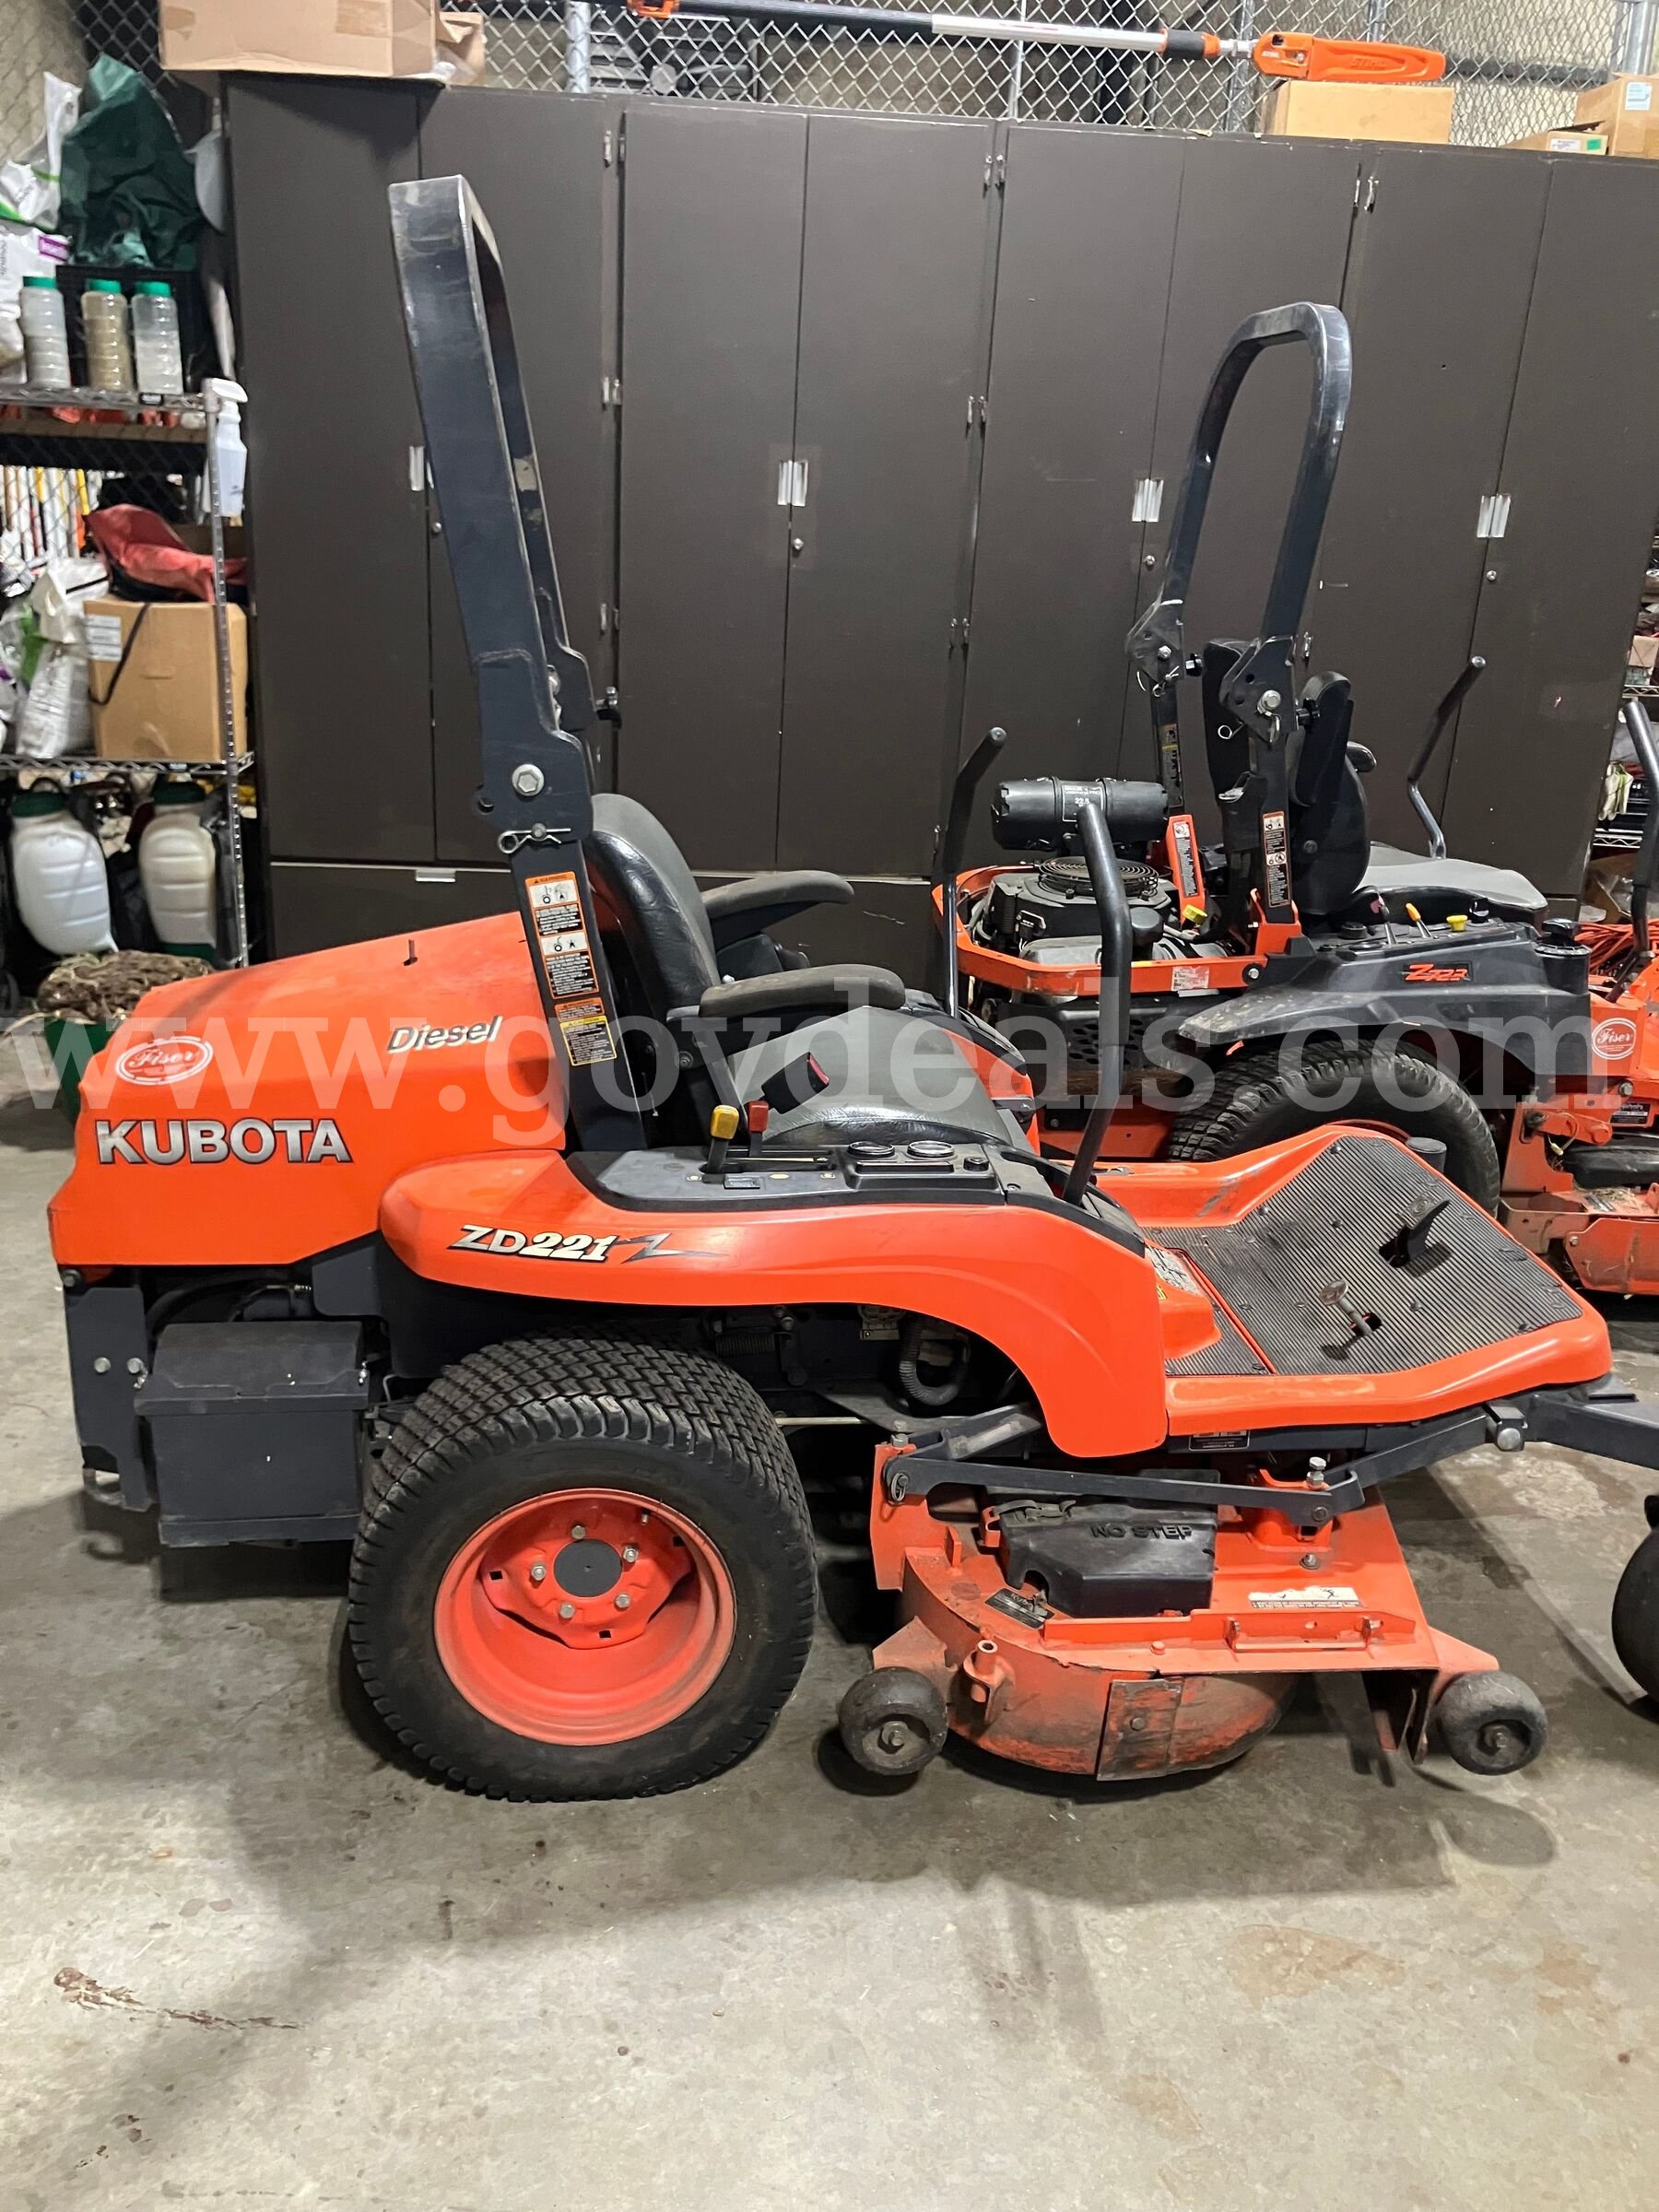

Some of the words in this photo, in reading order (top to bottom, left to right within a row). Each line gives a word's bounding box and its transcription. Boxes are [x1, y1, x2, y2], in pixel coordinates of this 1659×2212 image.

[387, 1015, 503, 1054] Diesel
[1597, 1028, 1630, 1043] Fiser
[95, 1117, 354, 1165] KUBOTA
[446, 1224, 619, 1263] ZD221
[1090, 1525, 1126, 1538] NO
[1132, 1524, 1192, 1540] STEP
